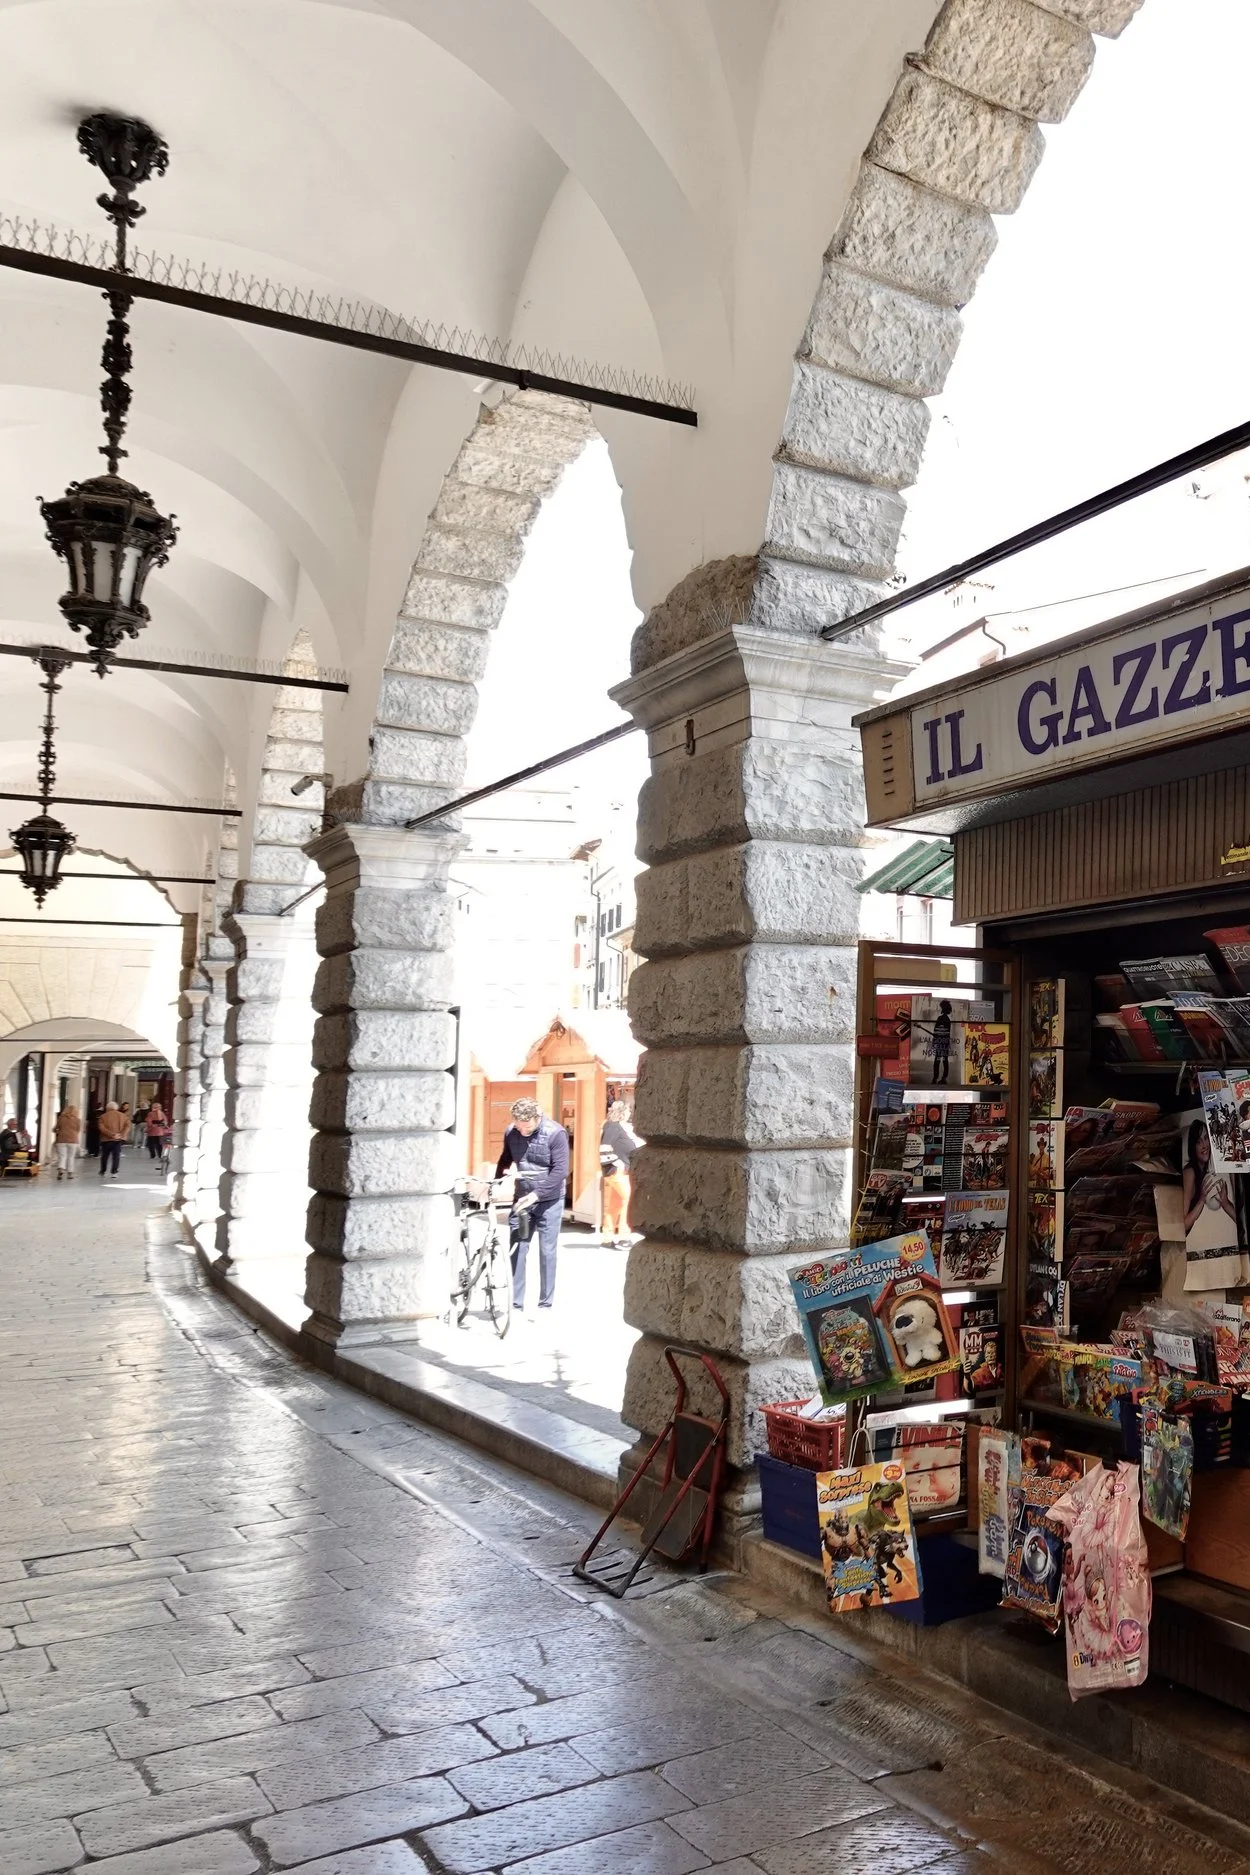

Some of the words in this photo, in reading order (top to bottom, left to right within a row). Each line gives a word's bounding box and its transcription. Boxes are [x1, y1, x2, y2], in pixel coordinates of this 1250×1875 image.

[924, 709, 983, 785] IL
[902, 1241, 924, 1255] 14,50
[831, 1278, 845, 1287] con
[853, 1257, 900, 1278] PELUCHE
[831, 1276, 871, 1297] ufficiale
[873, 1273, 882, 1284] di
[883, 1263, 924, 1281] Westie
